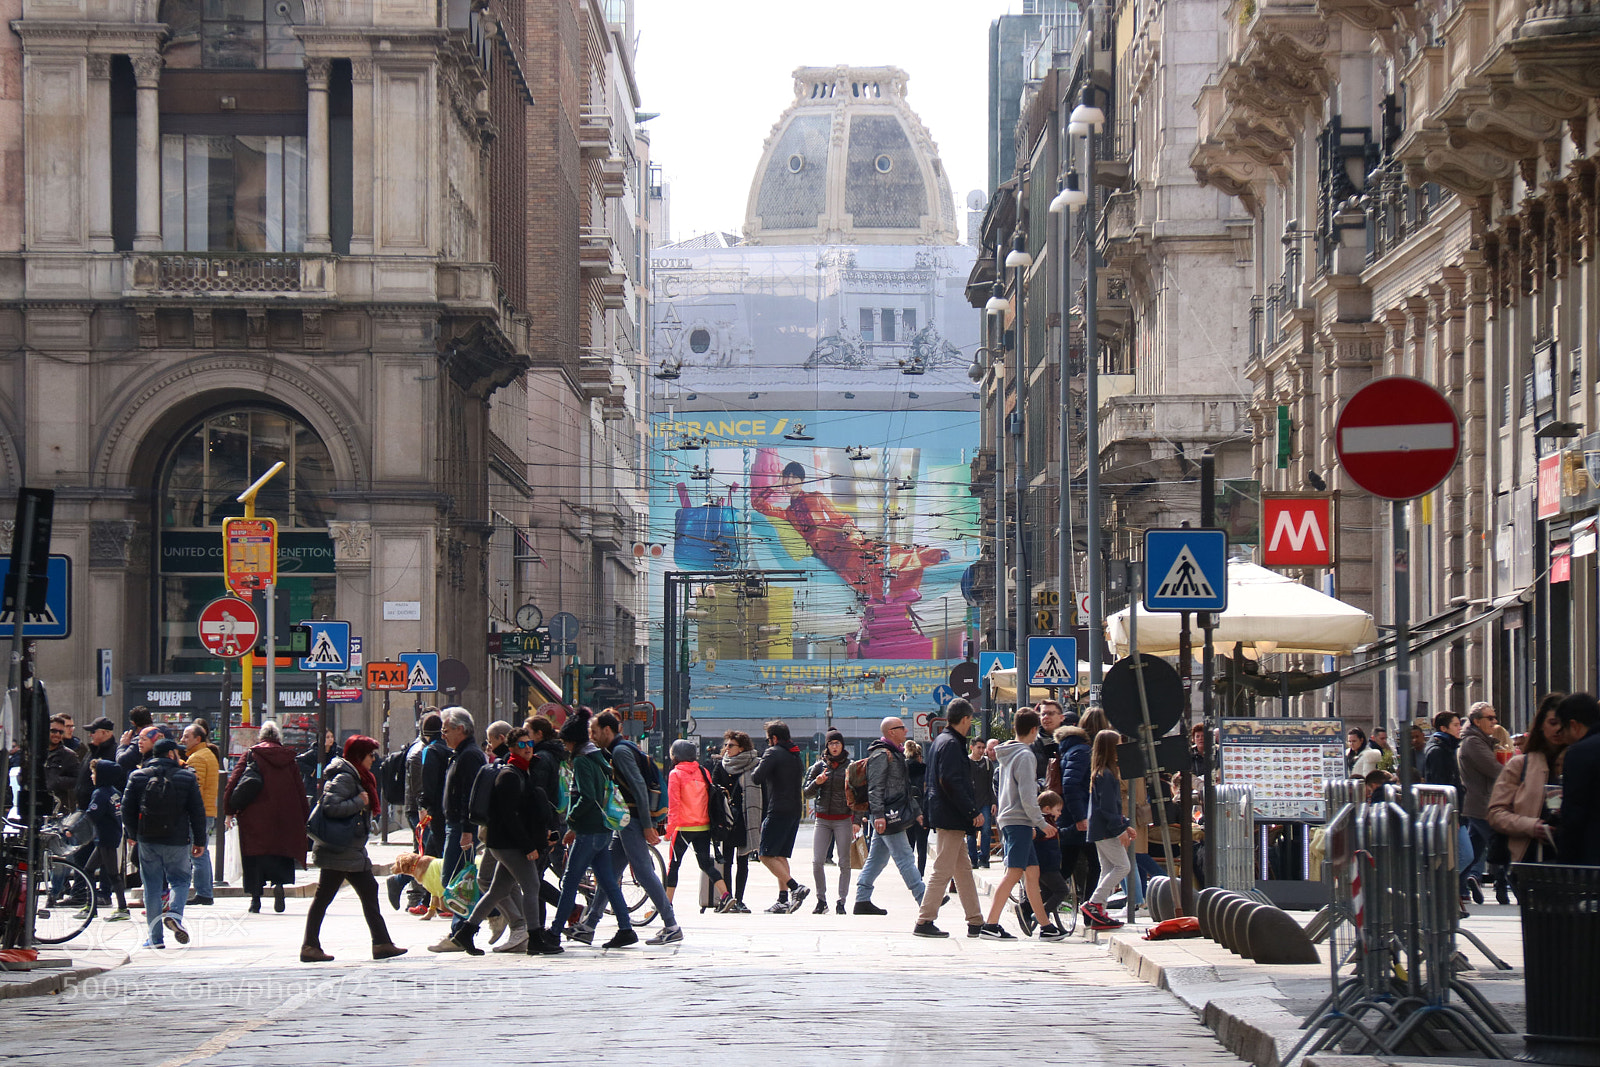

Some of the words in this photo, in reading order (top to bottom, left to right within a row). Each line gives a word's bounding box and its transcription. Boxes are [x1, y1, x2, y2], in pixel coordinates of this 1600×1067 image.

[651, 258, 692, 268] HOTEL
[164, 547, 206, 557] UNITED
[370, 670, 404, 682] TAXI
[760, 665, 776, 679] VI
[147, 691, 192, 701] SOUVENIR
[279, 691, 313, 702] MILANO
